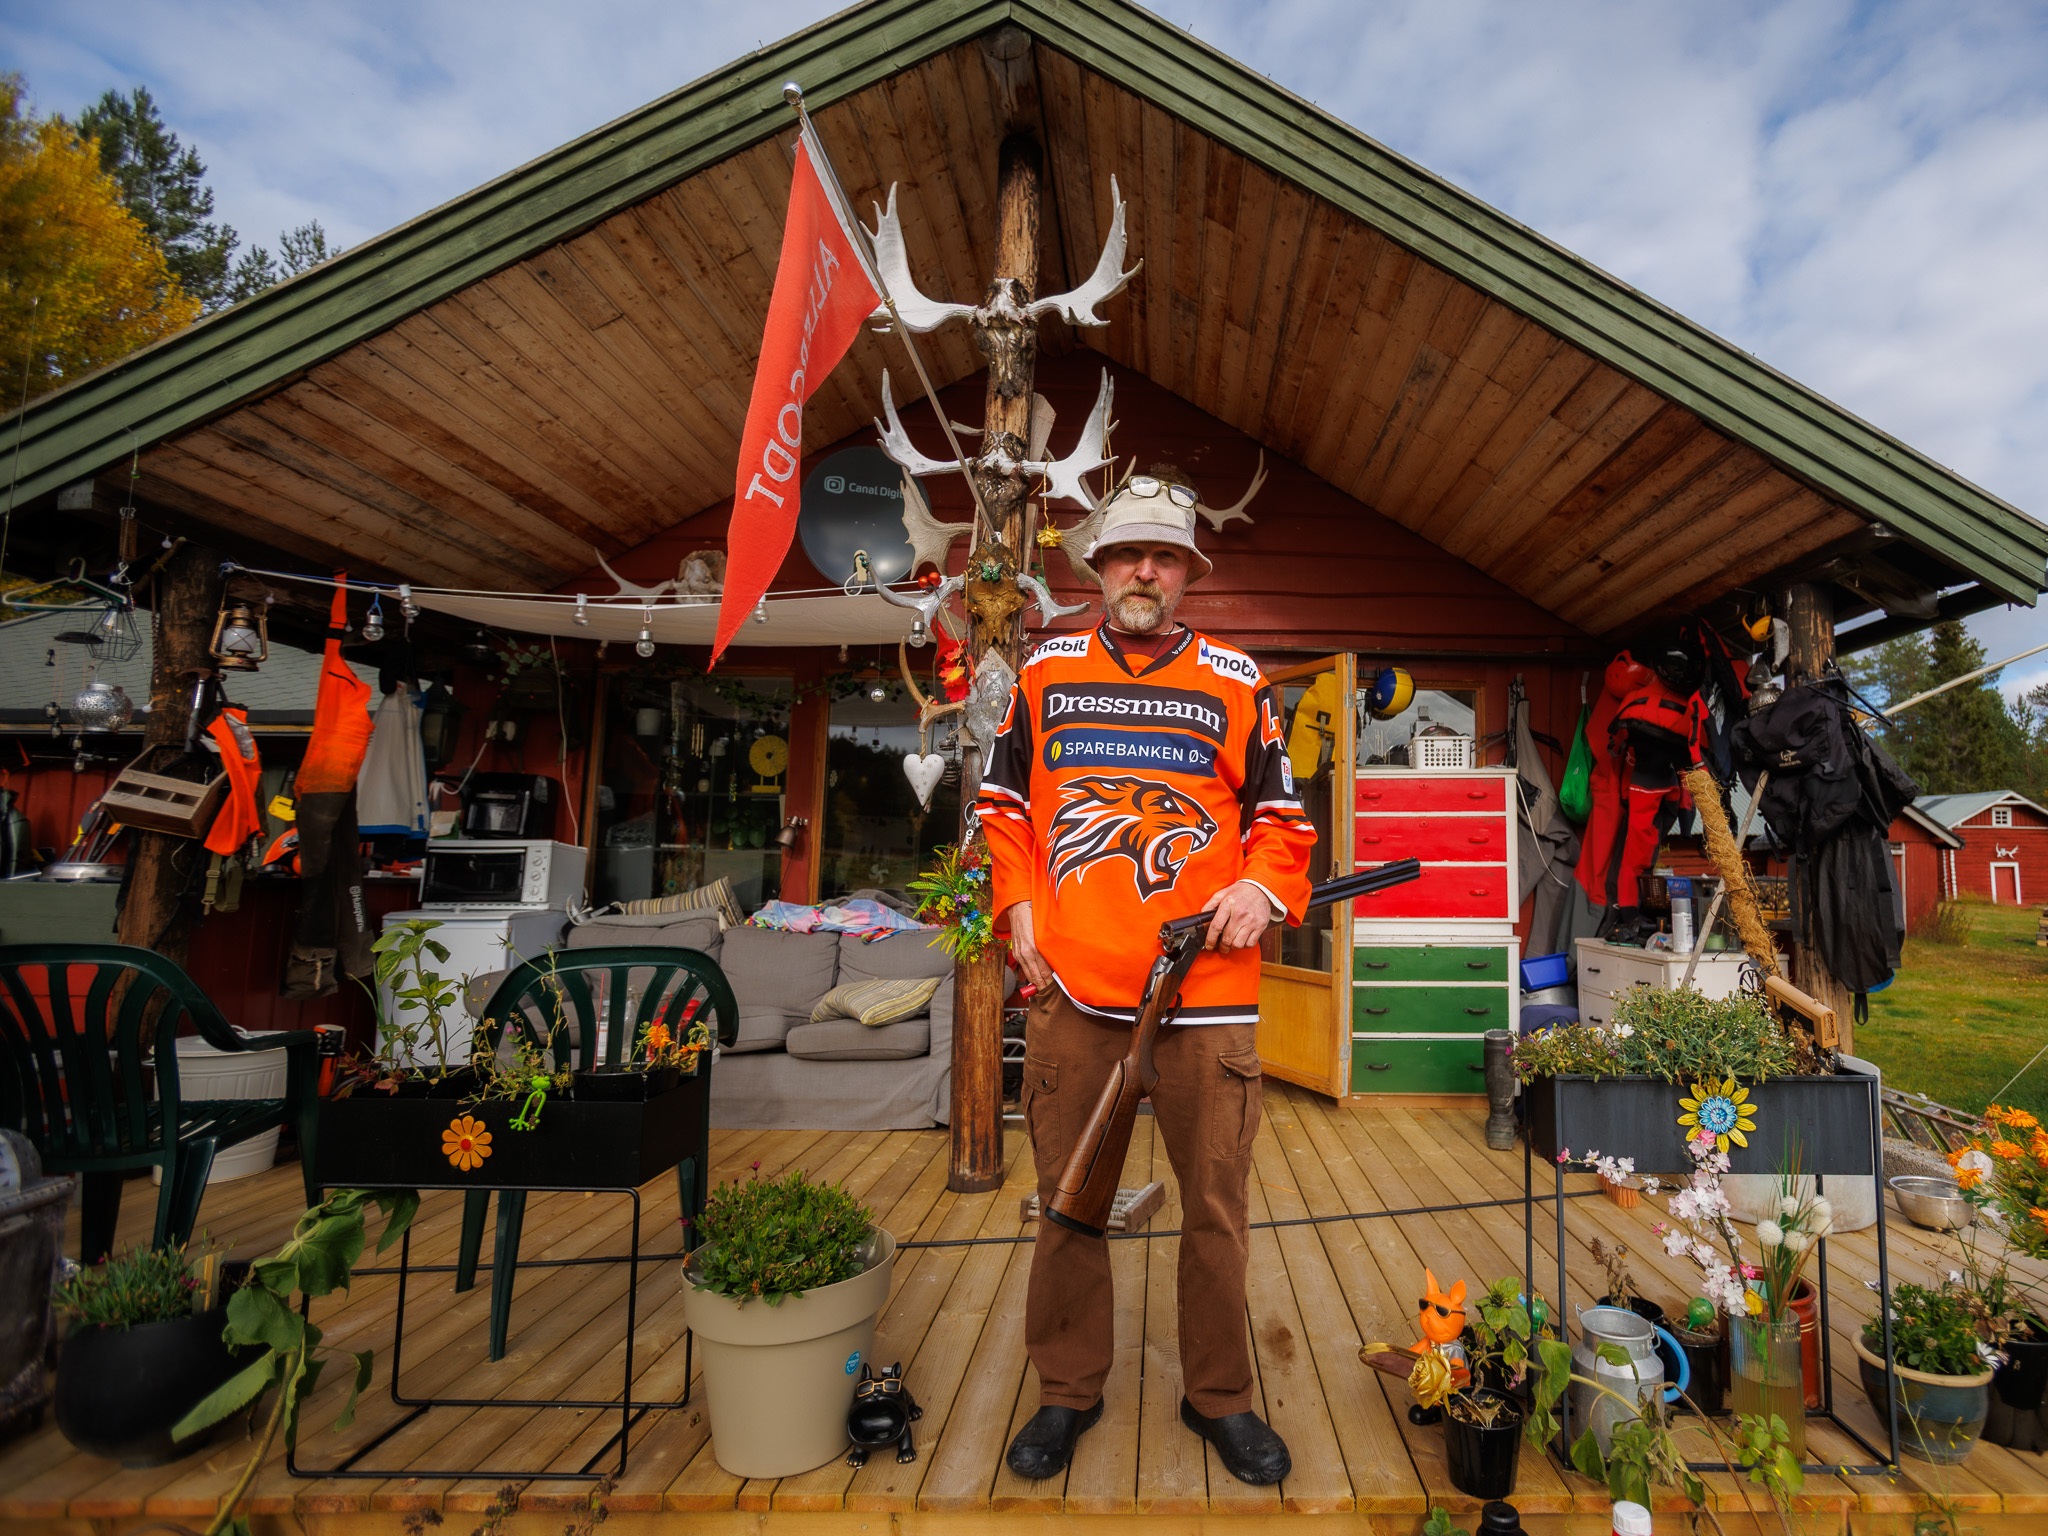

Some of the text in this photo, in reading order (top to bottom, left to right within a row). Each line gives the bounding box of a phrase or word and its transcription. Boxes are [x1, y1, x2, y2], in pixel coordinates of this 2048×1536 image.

[848, 483, 878, 495] Canal
[1048, 693, 1221, 733] Dressmann
[1065, 742, 1183, 762] SPAREBANKEN
